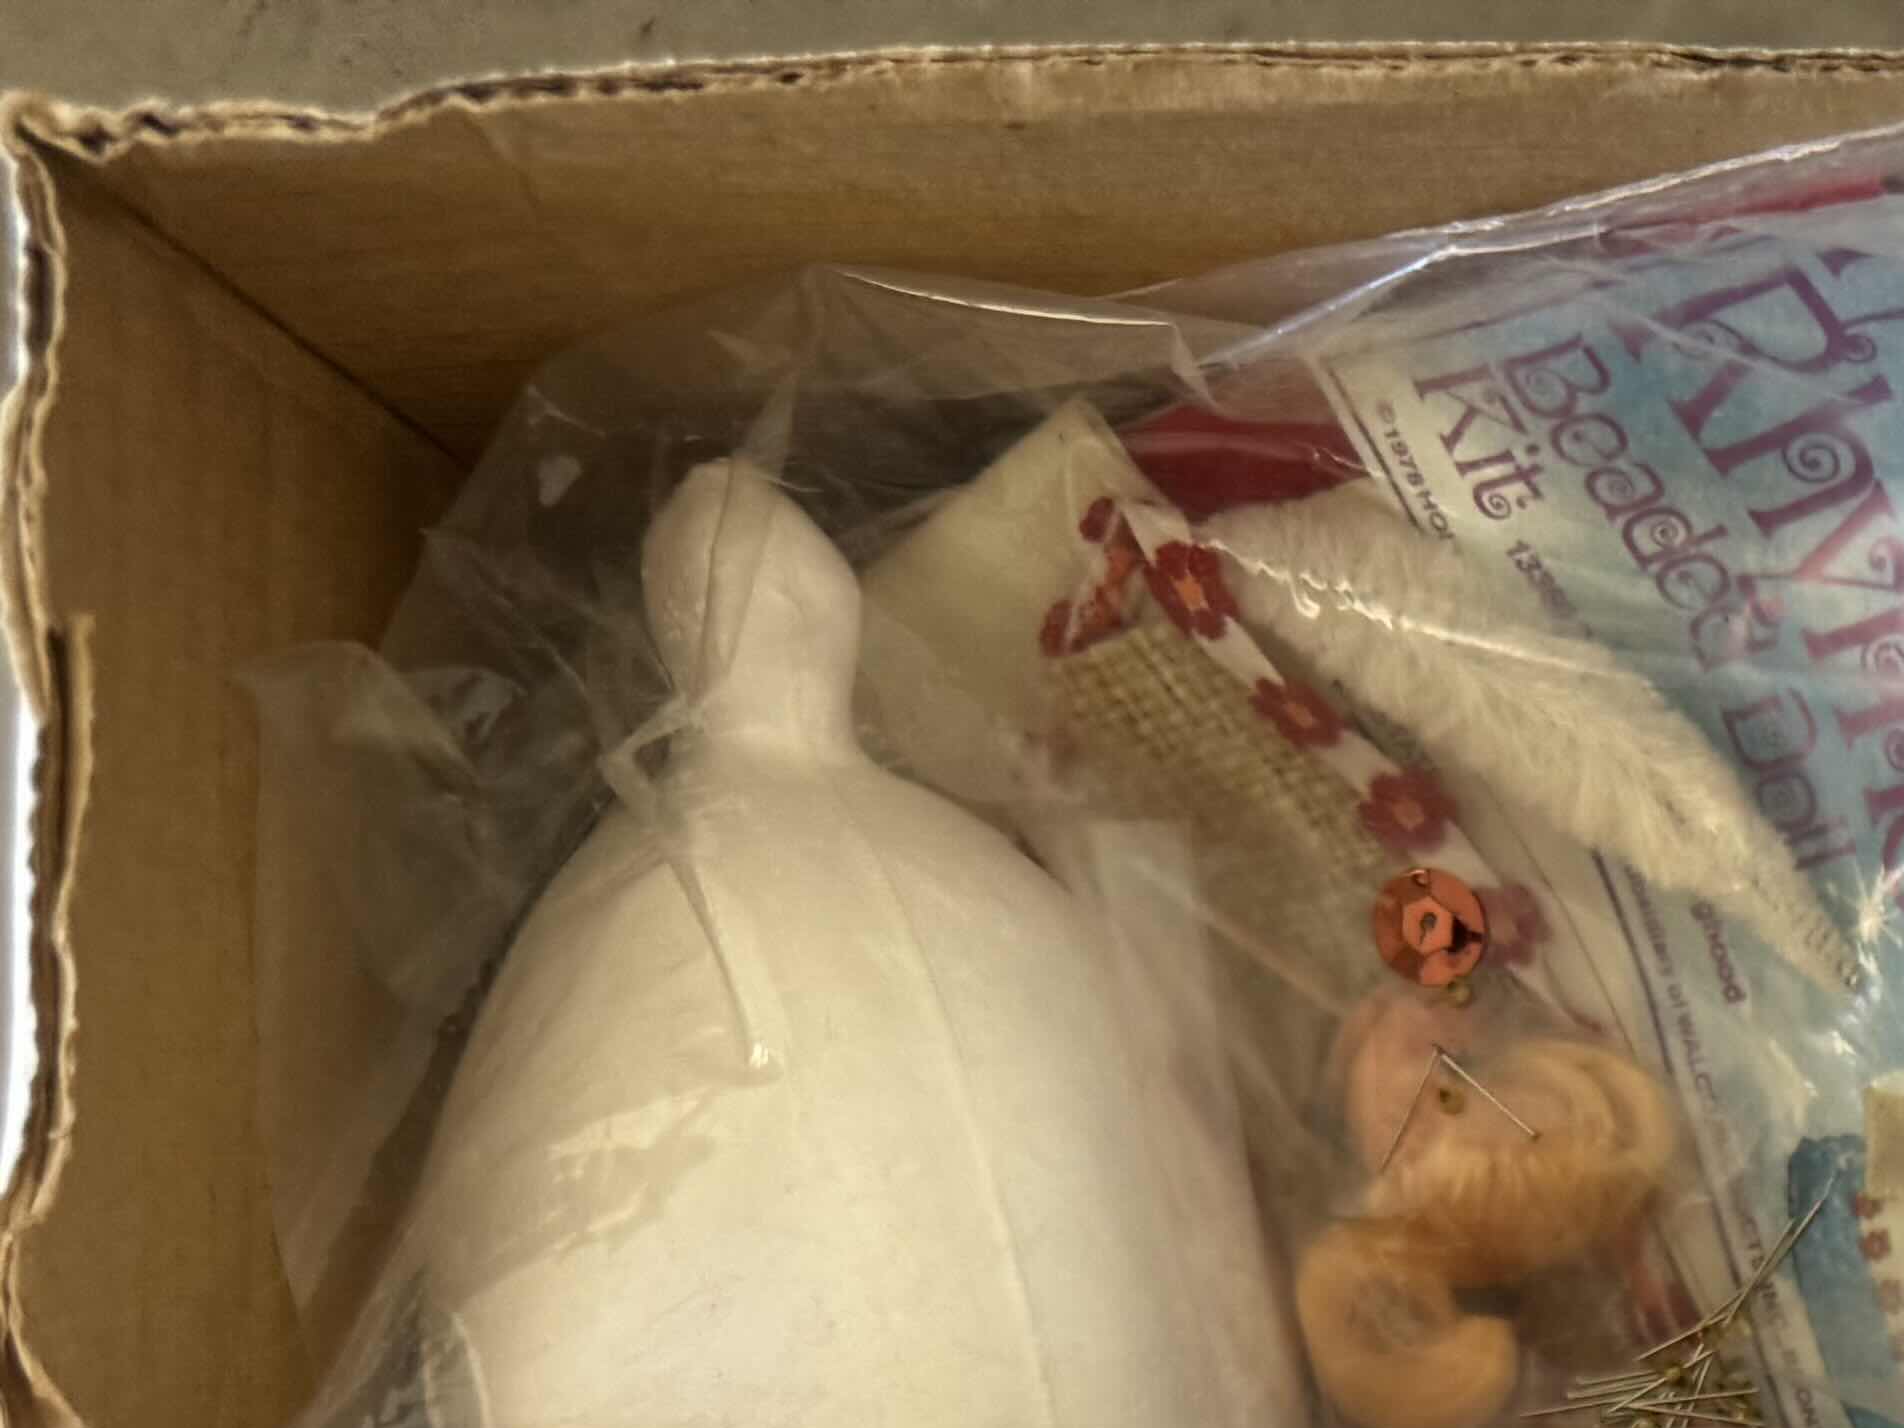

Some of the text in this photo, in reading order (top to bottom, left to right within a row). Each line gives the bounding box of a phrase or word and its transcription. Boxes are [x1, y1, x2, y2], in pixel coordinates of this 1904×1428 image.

[1413, 362, 1545, 521] Kit
[1495, 330, 1857, 870] Beaded Doll
